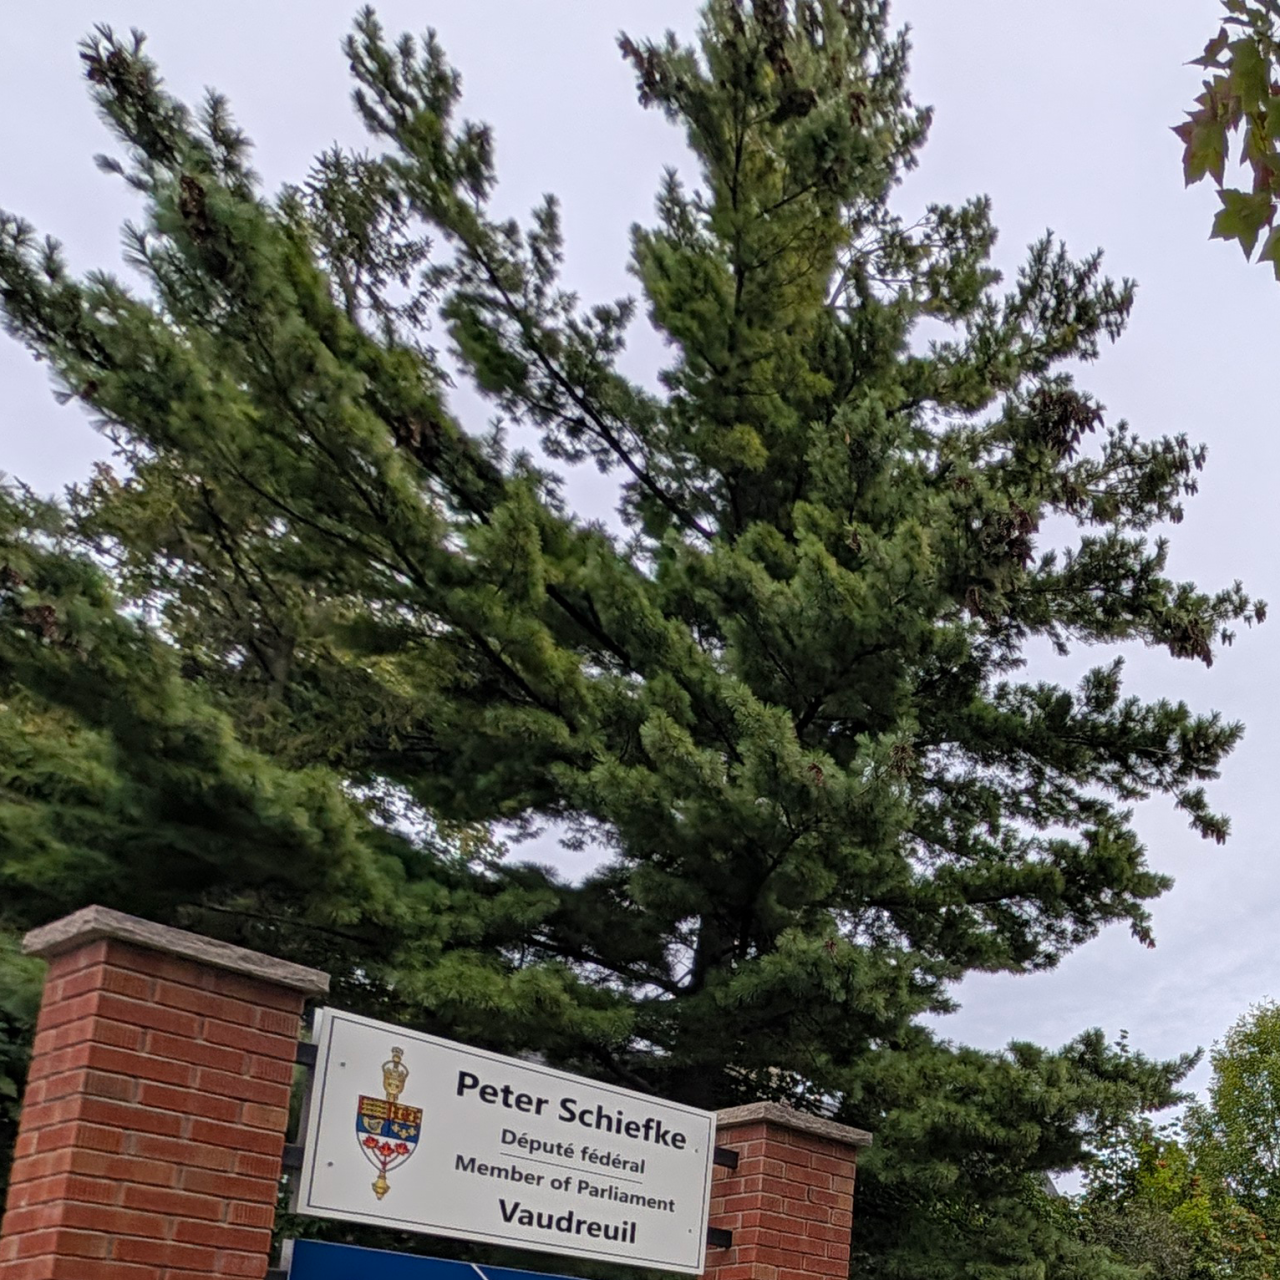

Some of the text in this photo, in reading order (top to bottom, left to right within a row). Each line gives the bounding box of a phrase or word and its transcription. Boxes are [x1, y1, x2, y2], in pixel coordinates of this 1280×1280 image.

[456, 1070, 687, 1150] Peter Schiefke
[501, 1128, 645, 1174] Député fédéral
[455, 1154, 676, 1213] Member of Parliament
[499, 1198, 637, 1244] Vaudreuil
